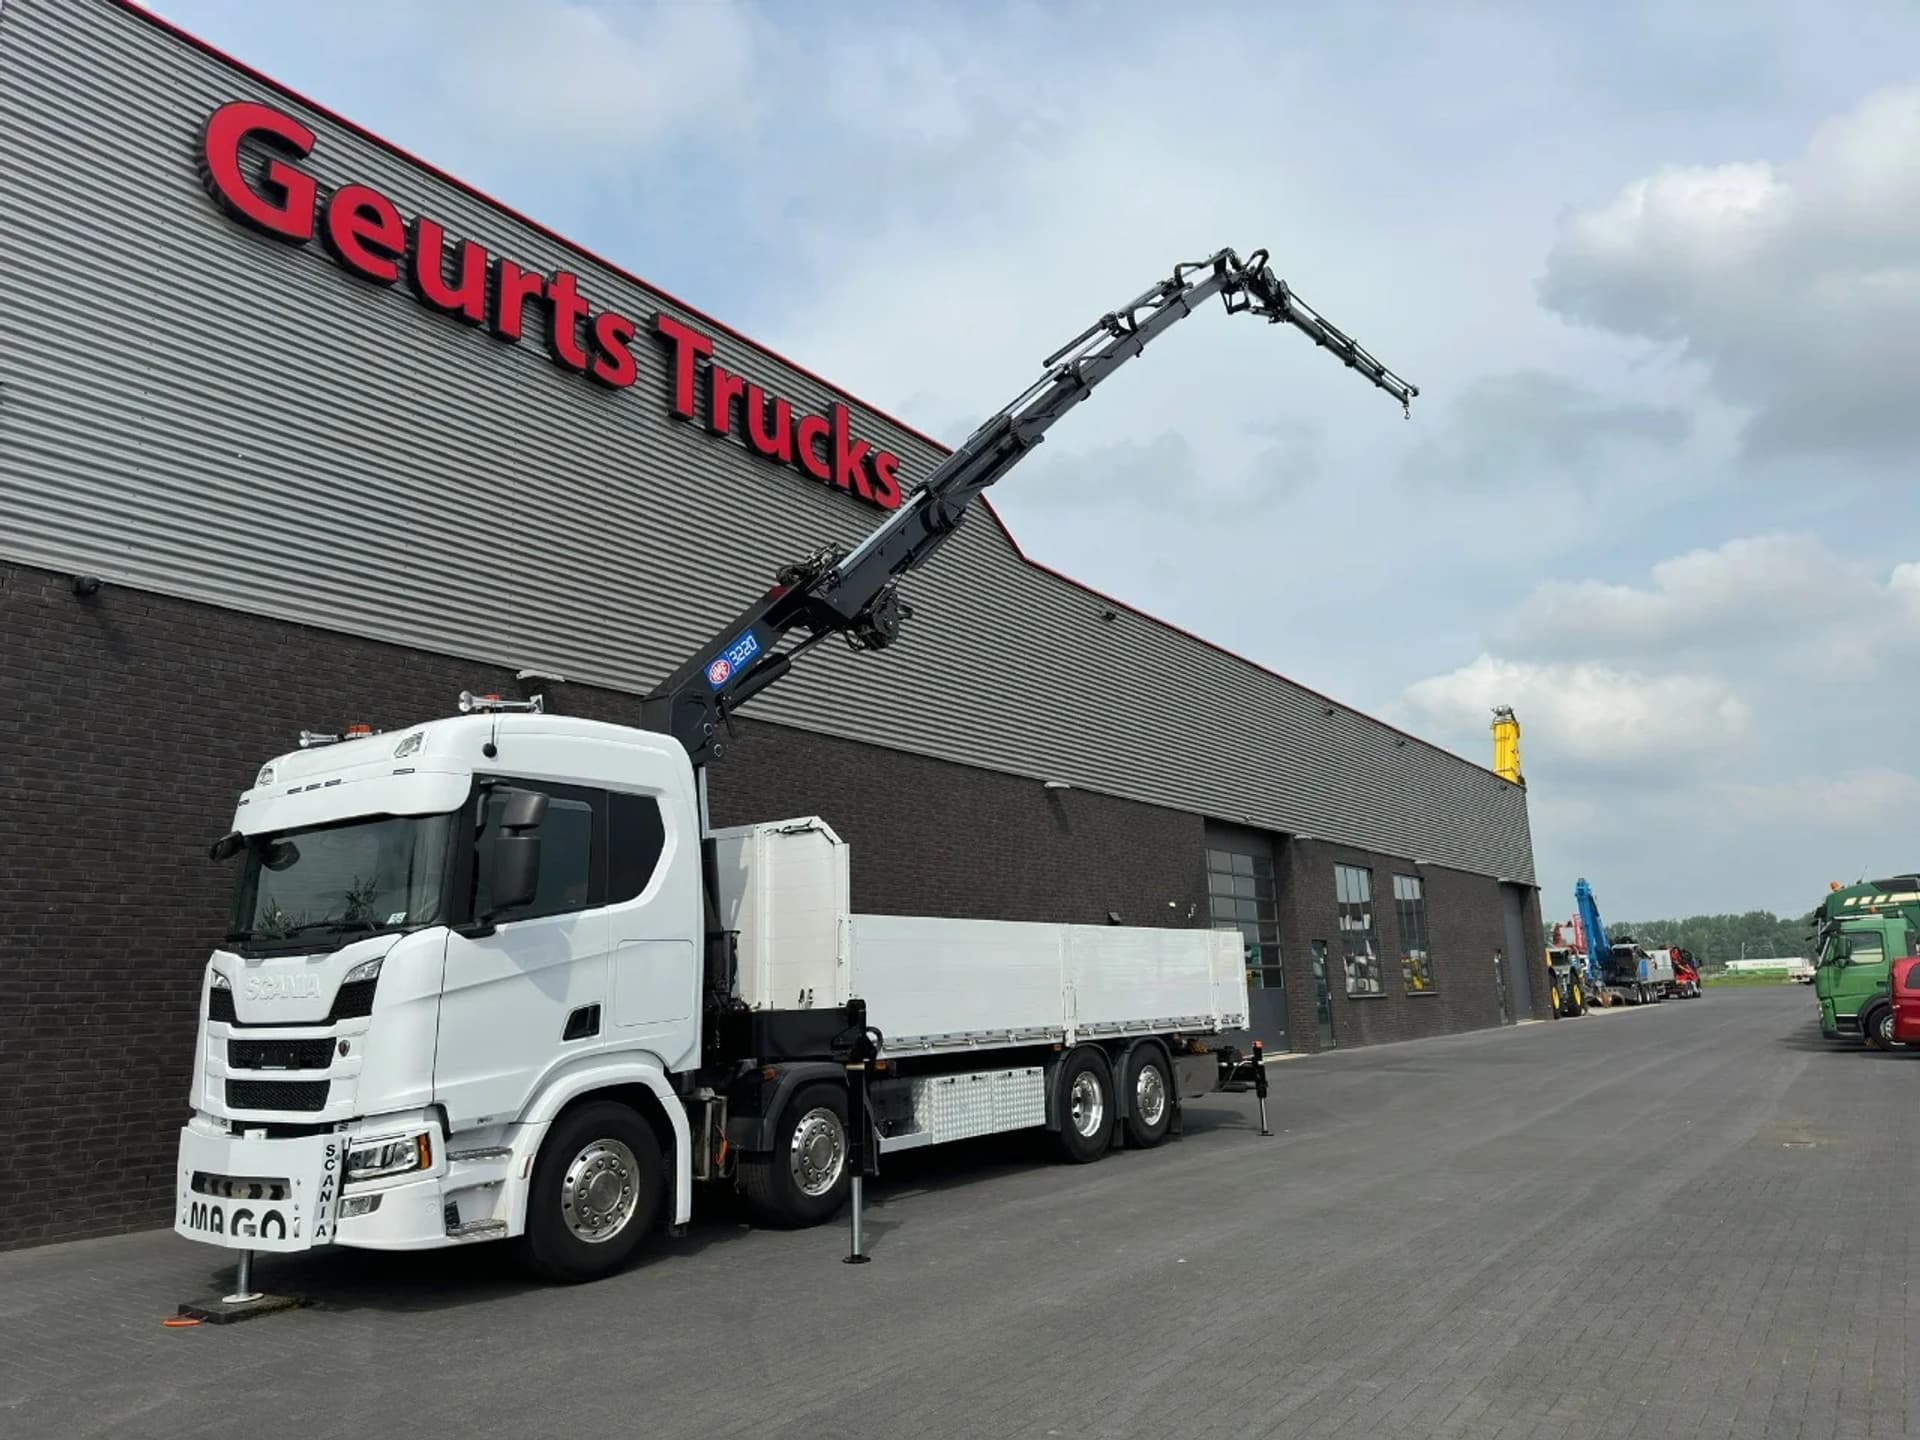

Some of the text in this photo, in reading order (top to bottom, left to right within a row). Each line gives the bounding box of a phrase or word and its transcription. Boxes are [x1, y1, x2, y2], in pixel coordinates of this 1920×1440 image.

[202, 100, 901, 509] Geurts Trucks
[729, 635, 757, 666] 3220
[246, 975, 320, 1000] SCANIA
[315, 1144, 336, 1237] SCANIA
